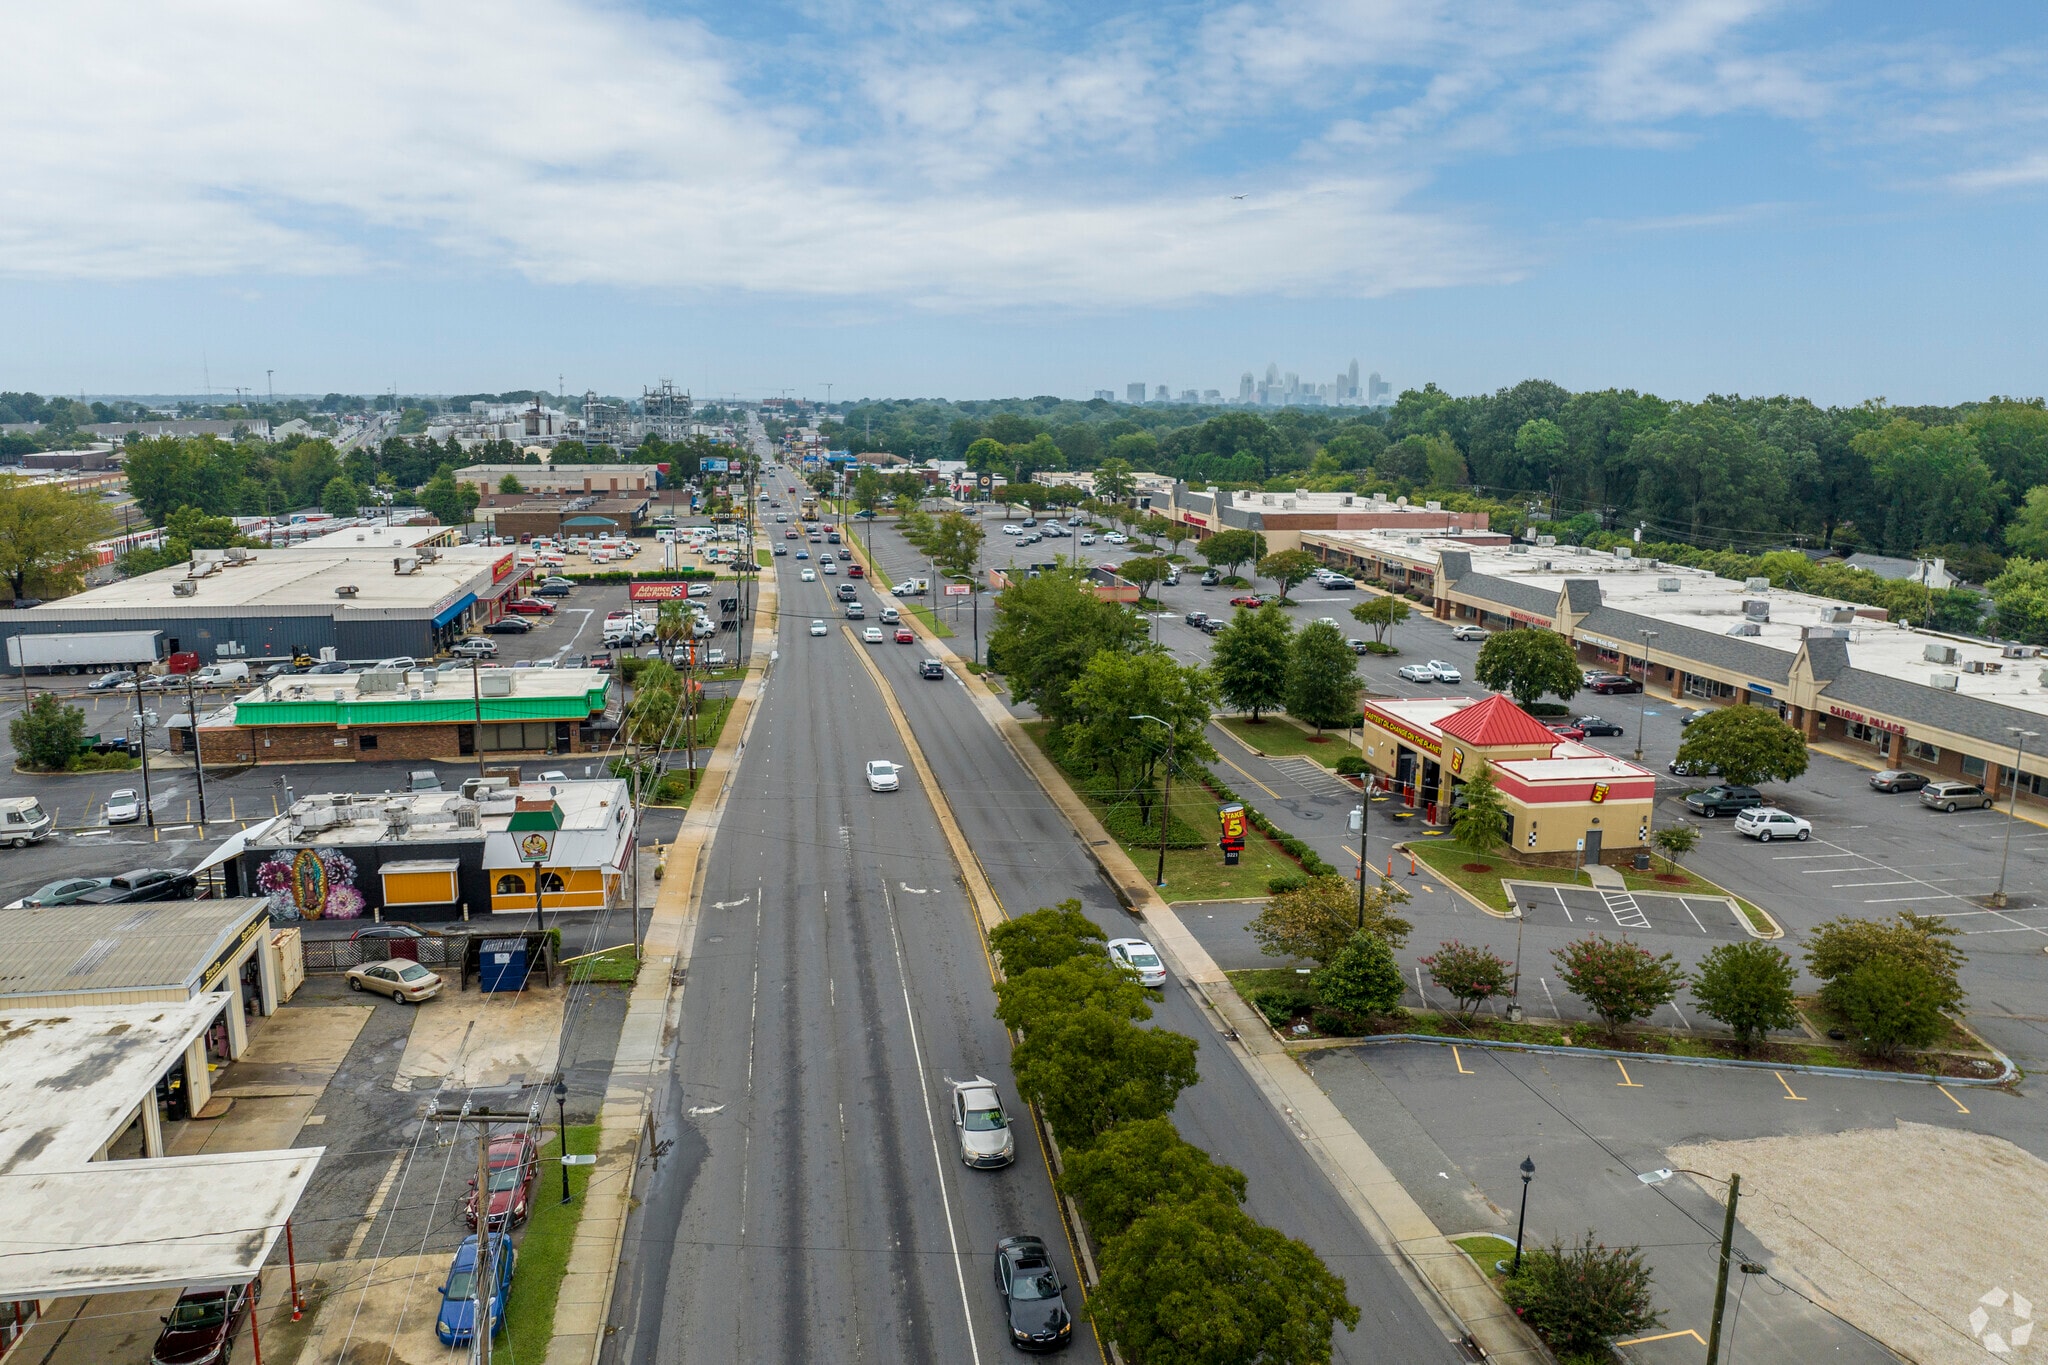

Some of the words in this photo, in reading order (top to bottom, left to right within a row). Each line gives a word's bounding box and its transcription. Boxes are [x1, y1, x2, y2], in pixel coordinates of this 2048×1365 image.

[1830, 705, 1864, 723] SAIGON
[1869, 716, 1906, 735] PALACE
[1365, 711, 1384, 725] FASTEST
[1389, 723, 1408, 737] CHANGE
[1424, 740, 1442, 754] PLANET
[1594, 791, 1602, 802] 5
[1226, 810, 1244, 819] TAKE
[1228, 819, 1243, 836] 5
